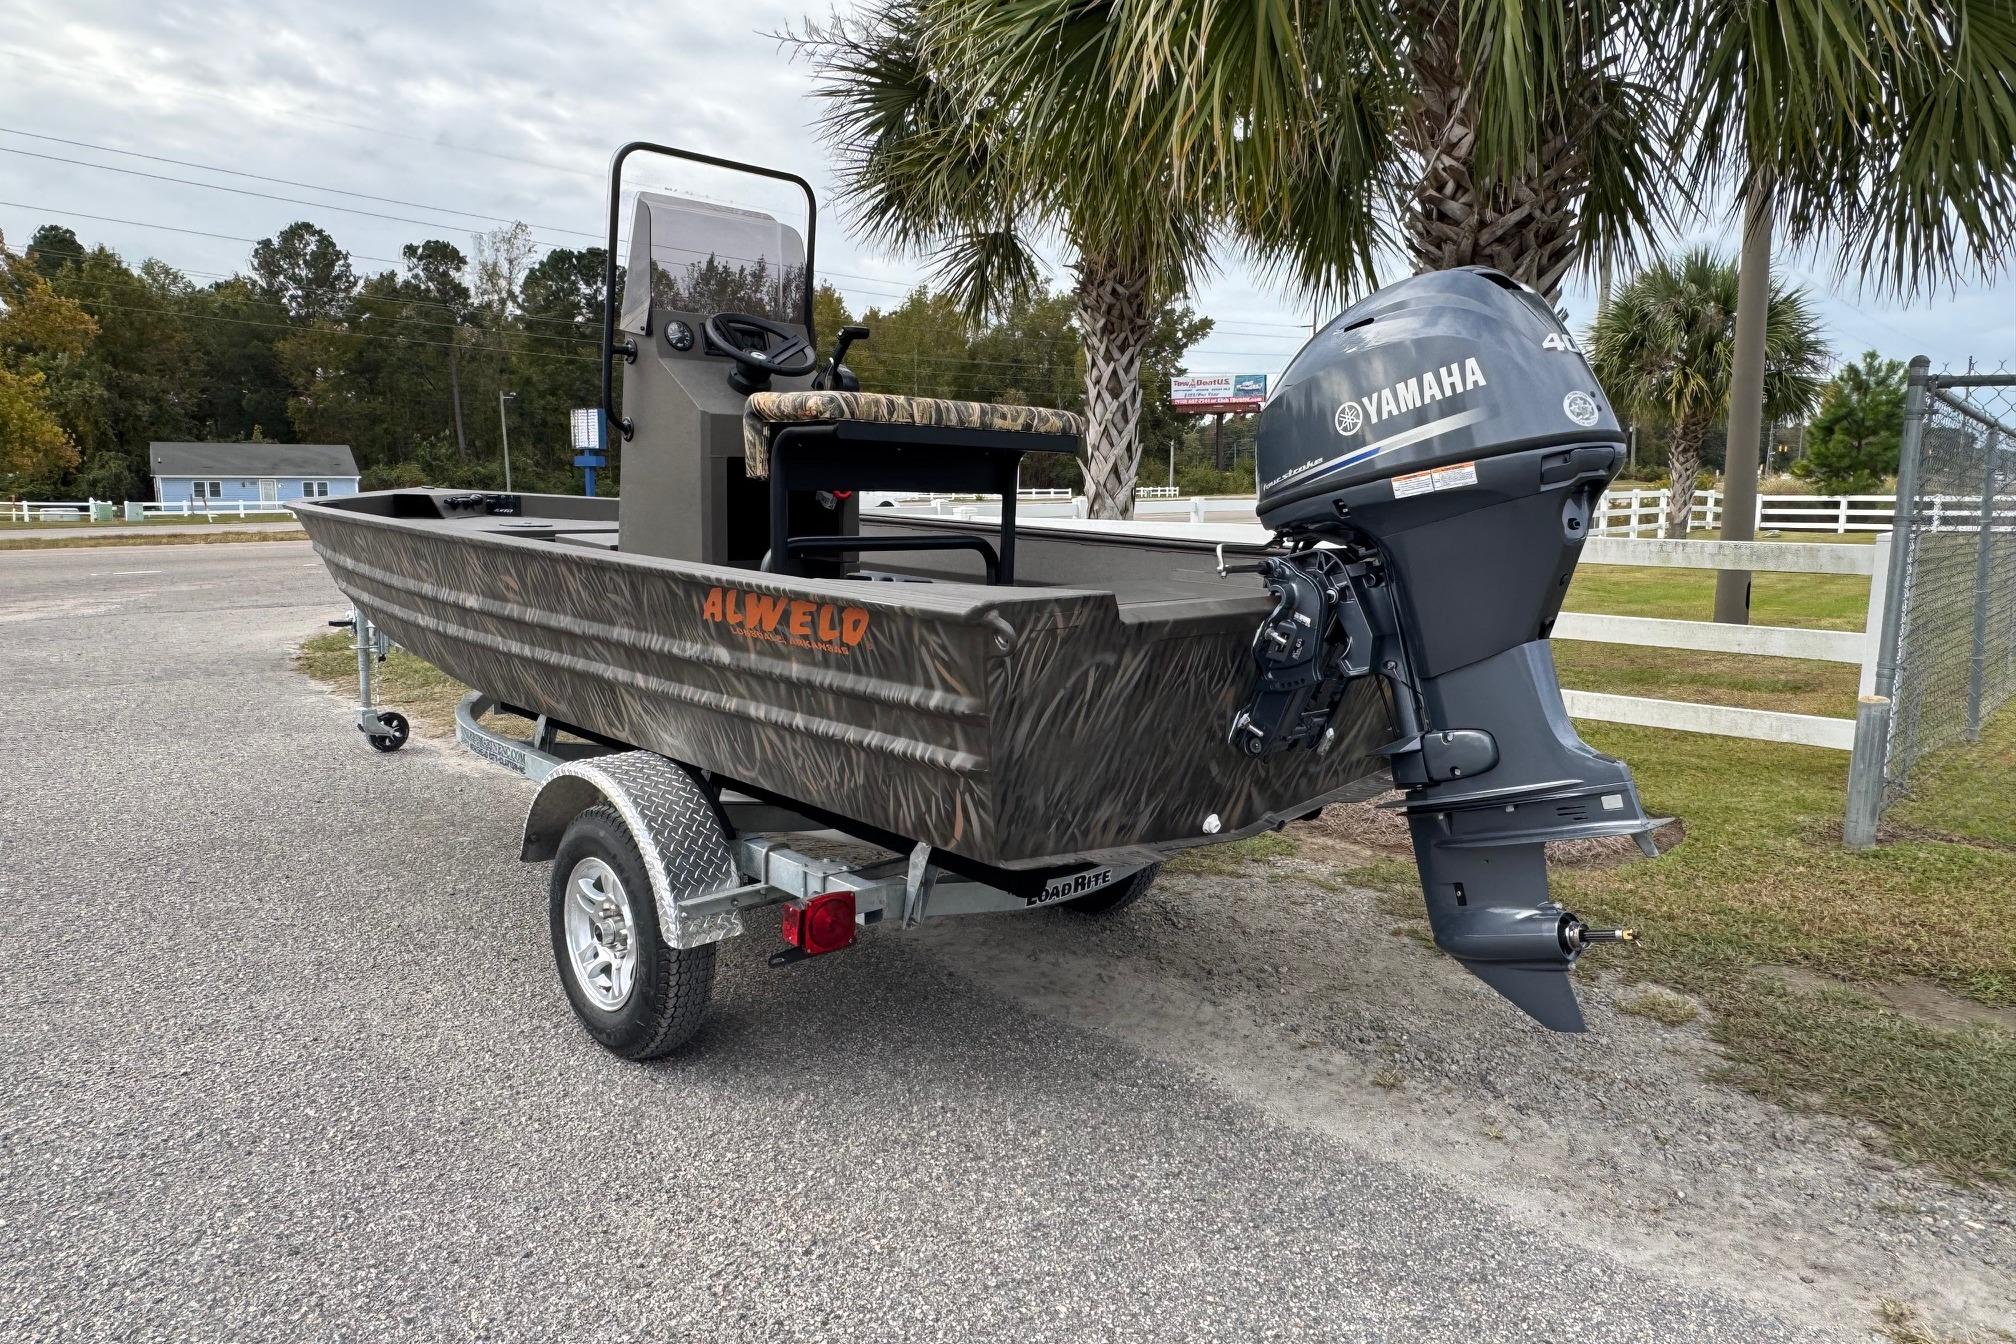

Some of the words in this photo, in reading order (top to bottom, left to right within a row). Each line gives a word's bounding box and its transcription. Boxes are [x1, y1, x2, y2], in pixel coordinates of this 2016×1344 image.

[1361, 356, 1487, 425] YAMAHA
[703, 587, 869, 646] ALWELD
[789, 638, 849, 655] ARKANSAS
